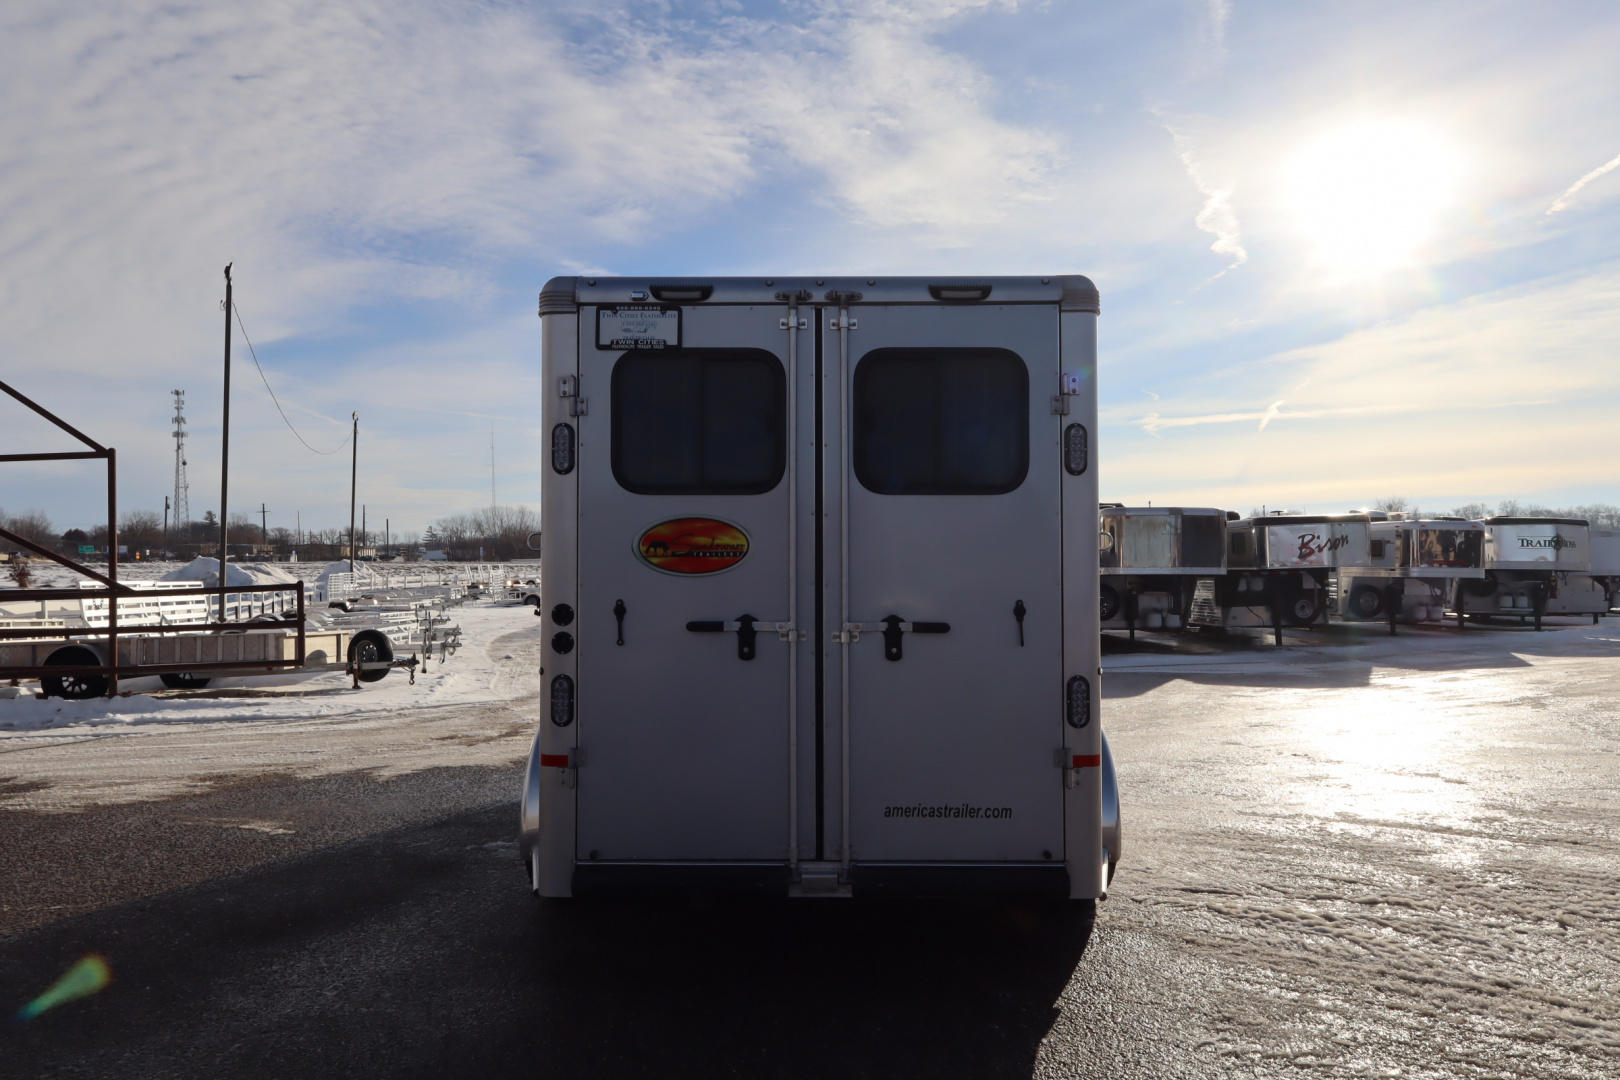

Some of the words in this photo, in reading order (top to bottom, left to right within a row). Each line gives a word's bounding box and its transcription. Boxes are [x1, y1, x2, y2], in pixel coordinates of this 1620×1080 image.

[671, 533, 746, 554] Sundowner
[1298, 533, 1349, 559] Bison
[884, 803, 1013, 819] americastrailer.com
